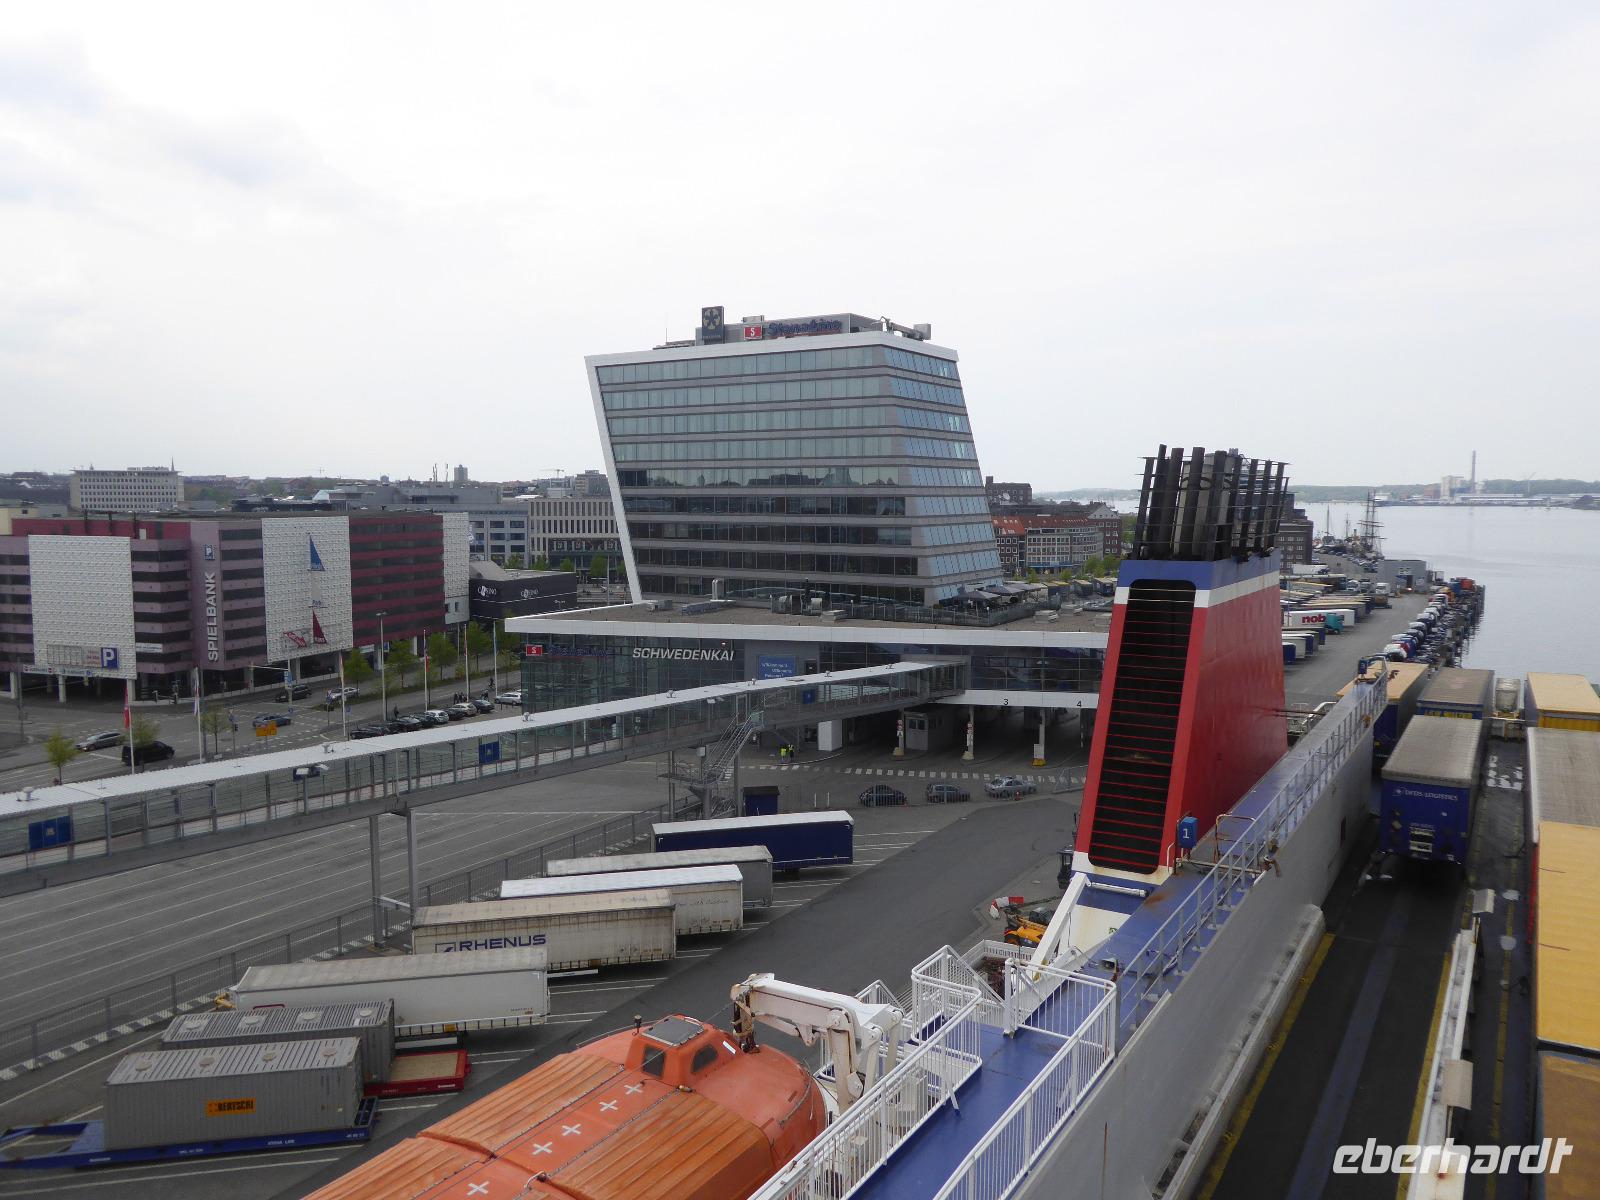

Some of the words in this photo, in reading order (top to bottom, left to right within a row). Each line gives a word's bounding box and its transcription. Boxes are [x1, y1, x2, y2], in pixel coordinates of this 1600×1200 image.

[205, 572, 219, 661] SPIELBANK
[102, 648, 114, 667] P
[632, 647, 735, 662] SCHWEDENKAI
[1076, 700, 1082, 708] 4
[1182, 828, 1190, 839] 1
[459, 934, 547, 952] RHENUS
[217, 1099, 254, 1112] BERTSCHI
